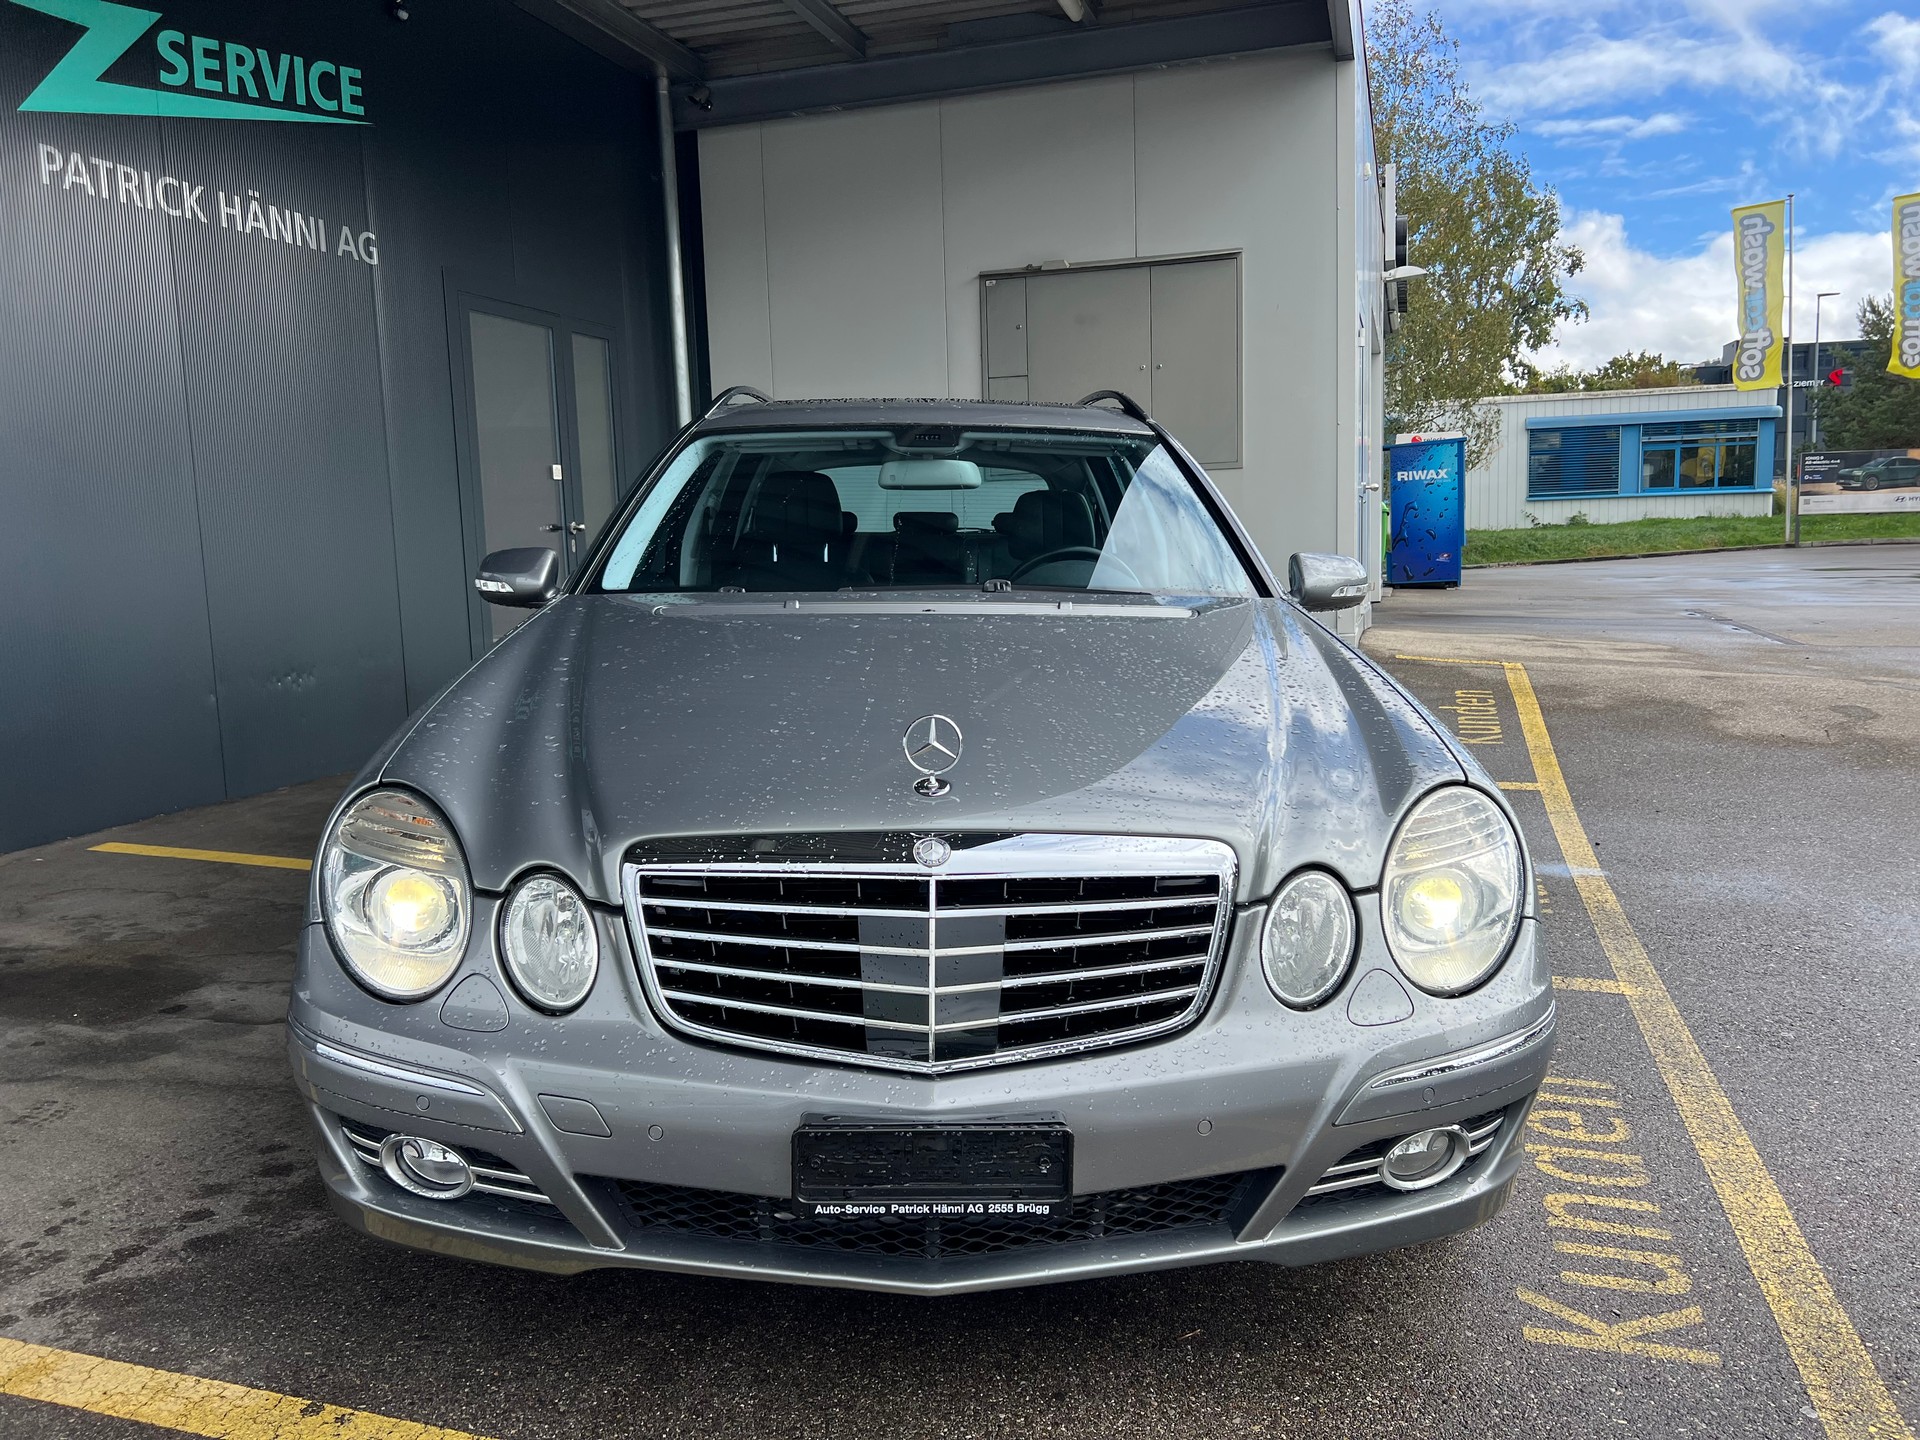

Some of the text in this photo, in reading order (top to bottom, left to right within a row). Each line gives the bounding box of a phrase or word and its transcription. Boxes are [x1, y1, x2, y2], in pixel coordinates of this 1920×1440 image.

[156, 29, 365, 116] SERVICE
[38, 142, 379, 265] PATRICK HÄNNI AG
[1397, 468, 1449, 482] RIWAX
[1438, 689, 1504, 745] Kunden
[814, 1203, 1050, 1216] Auto-Service Patrick Hänni AG 2555 Brügg
[1515, 1075, 1723, 1367] Kunden
